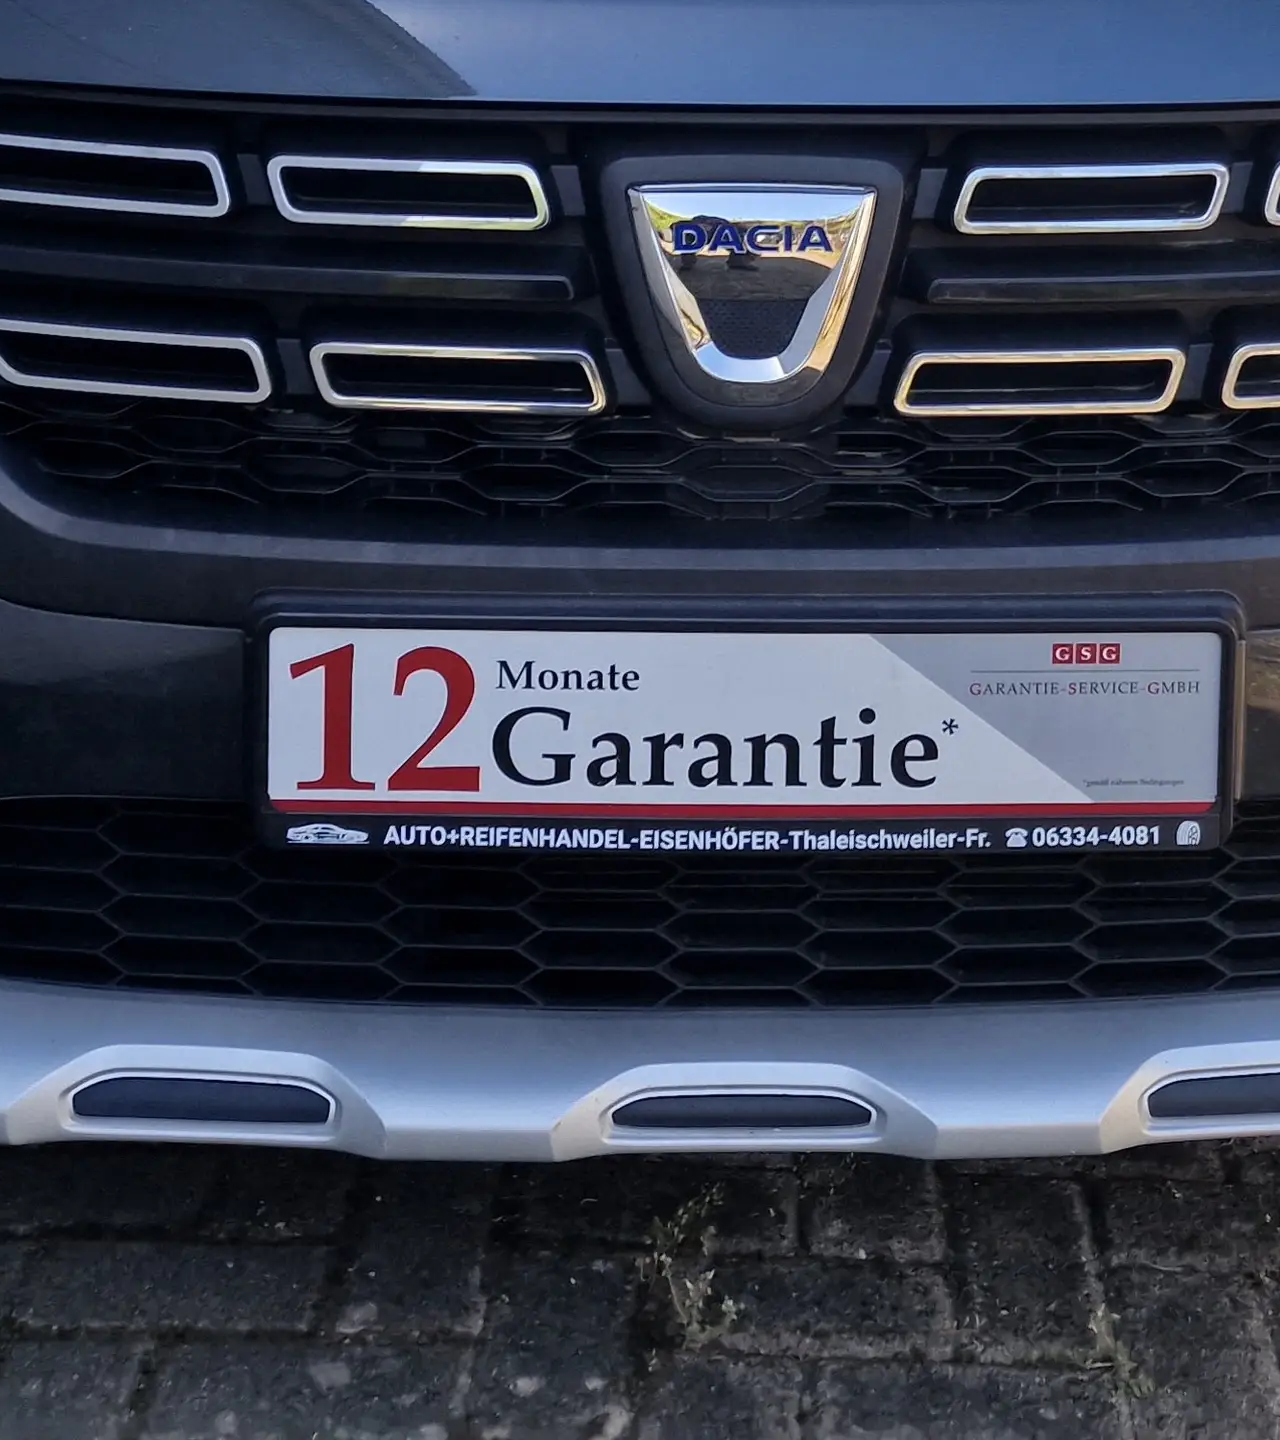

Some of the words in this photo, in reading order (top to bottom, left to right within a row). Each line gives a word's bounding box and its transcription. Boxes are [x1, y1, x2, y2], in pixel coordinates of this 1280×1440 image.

[673, 223, 833, 254] DACIA
[1054, 645, 1119, 662] GSG
[496, 660, 640, 690] Monate
[969, 681, 1200, 696] GARANTIE-SERVICE-GMBH
[290, 644, 480, 791] 12
[1032, 826, 1160, 847] 06334-4081
